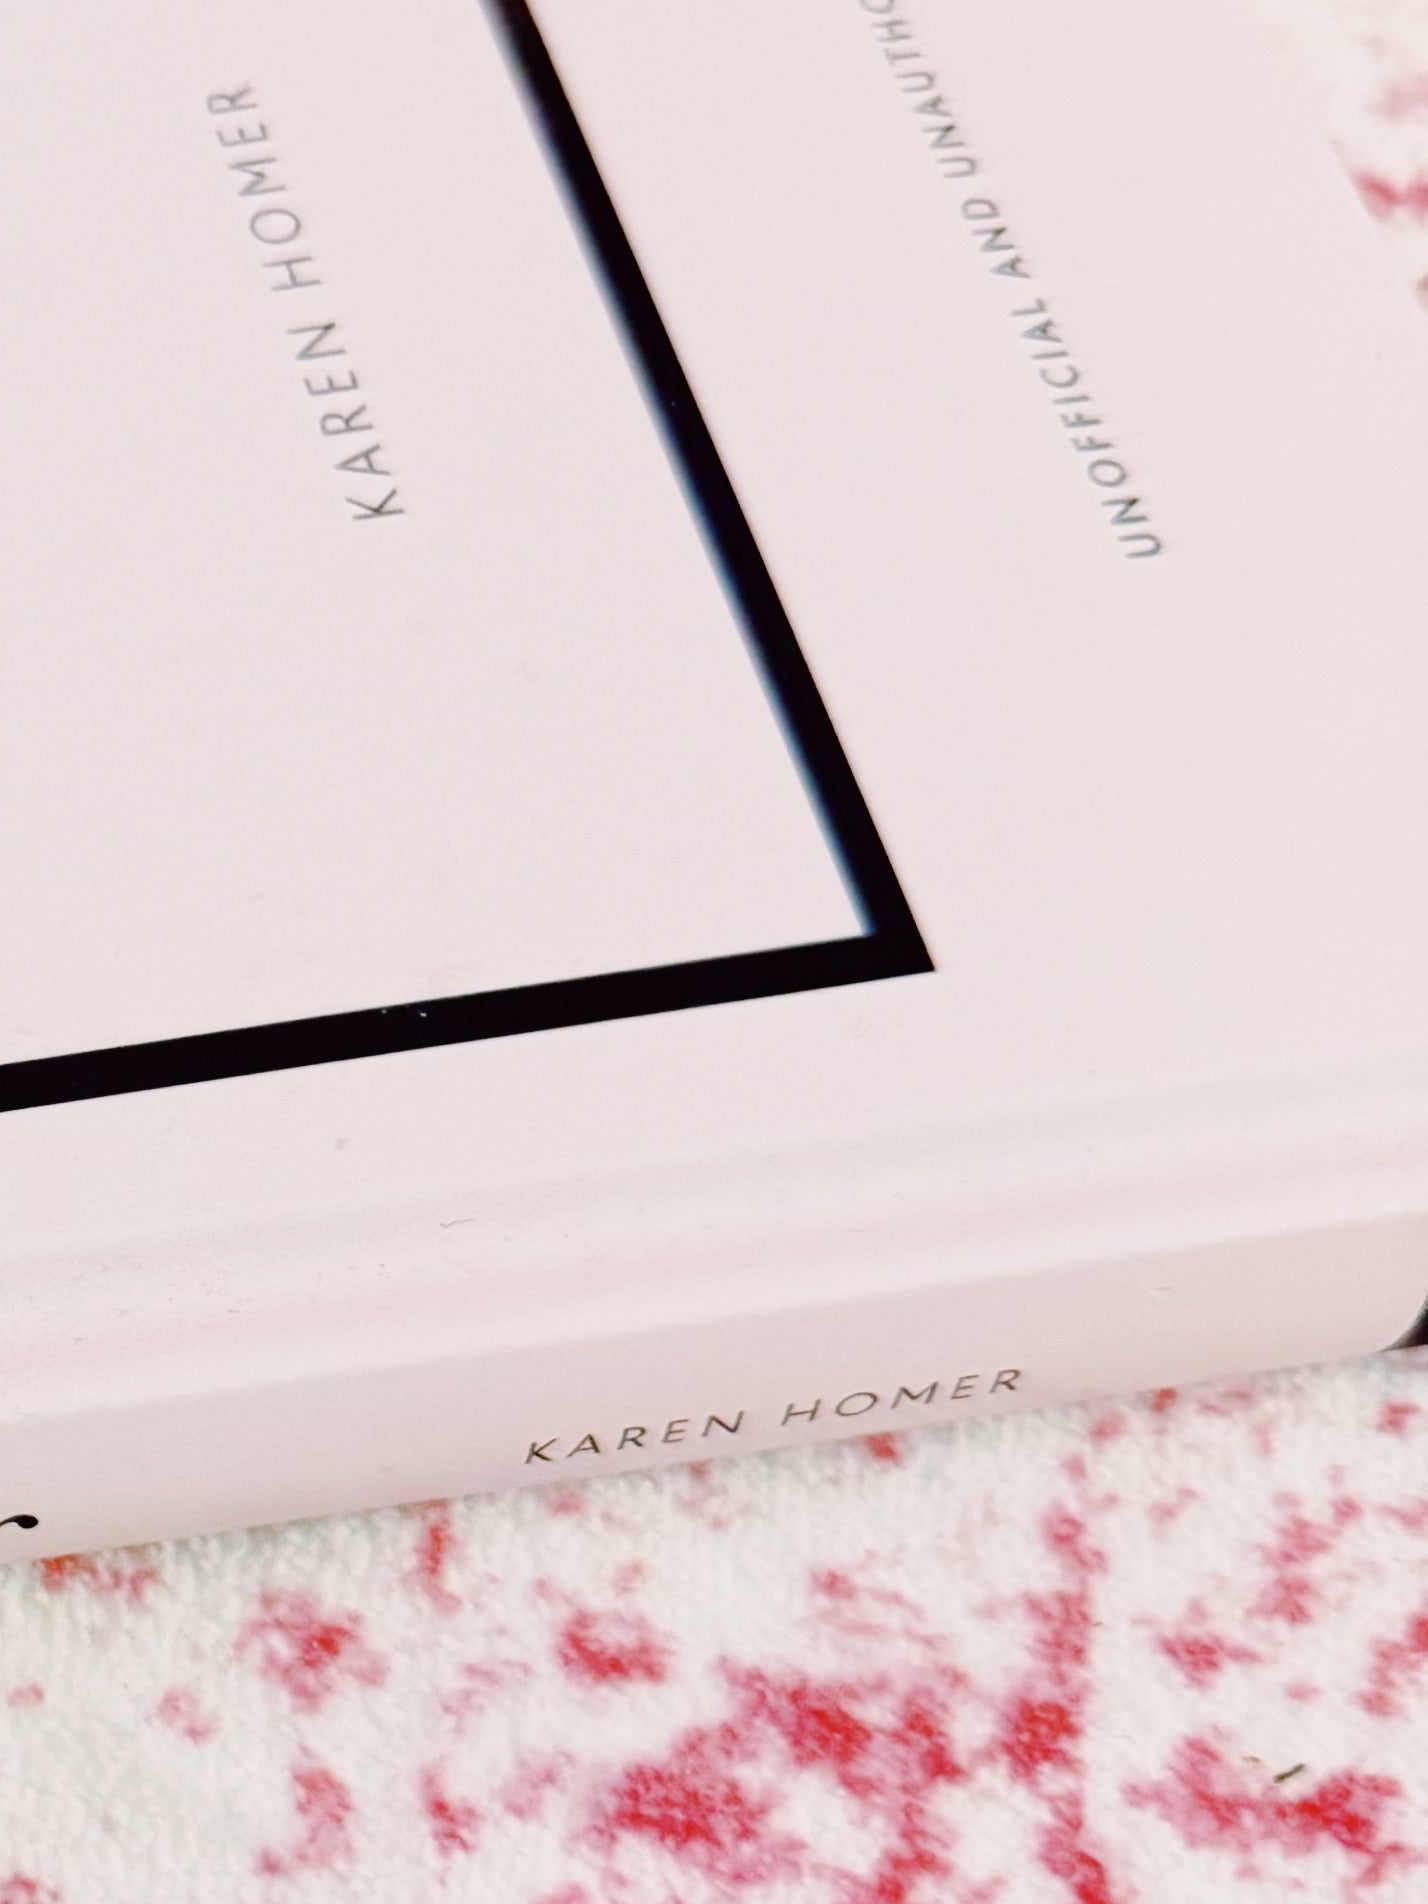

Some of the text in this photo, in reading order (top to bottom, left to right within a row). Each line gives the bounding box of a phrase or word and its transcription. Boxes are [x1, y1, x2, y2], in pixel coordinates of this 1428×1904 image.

[205, 84, 407, 522] KAREN HOMER
[960, 196, 1032, 280] AND
[1009, 296, 1165, 561] UNOFFICIAL
[524, 1367, 1023, 1466] KAREN HOMER
